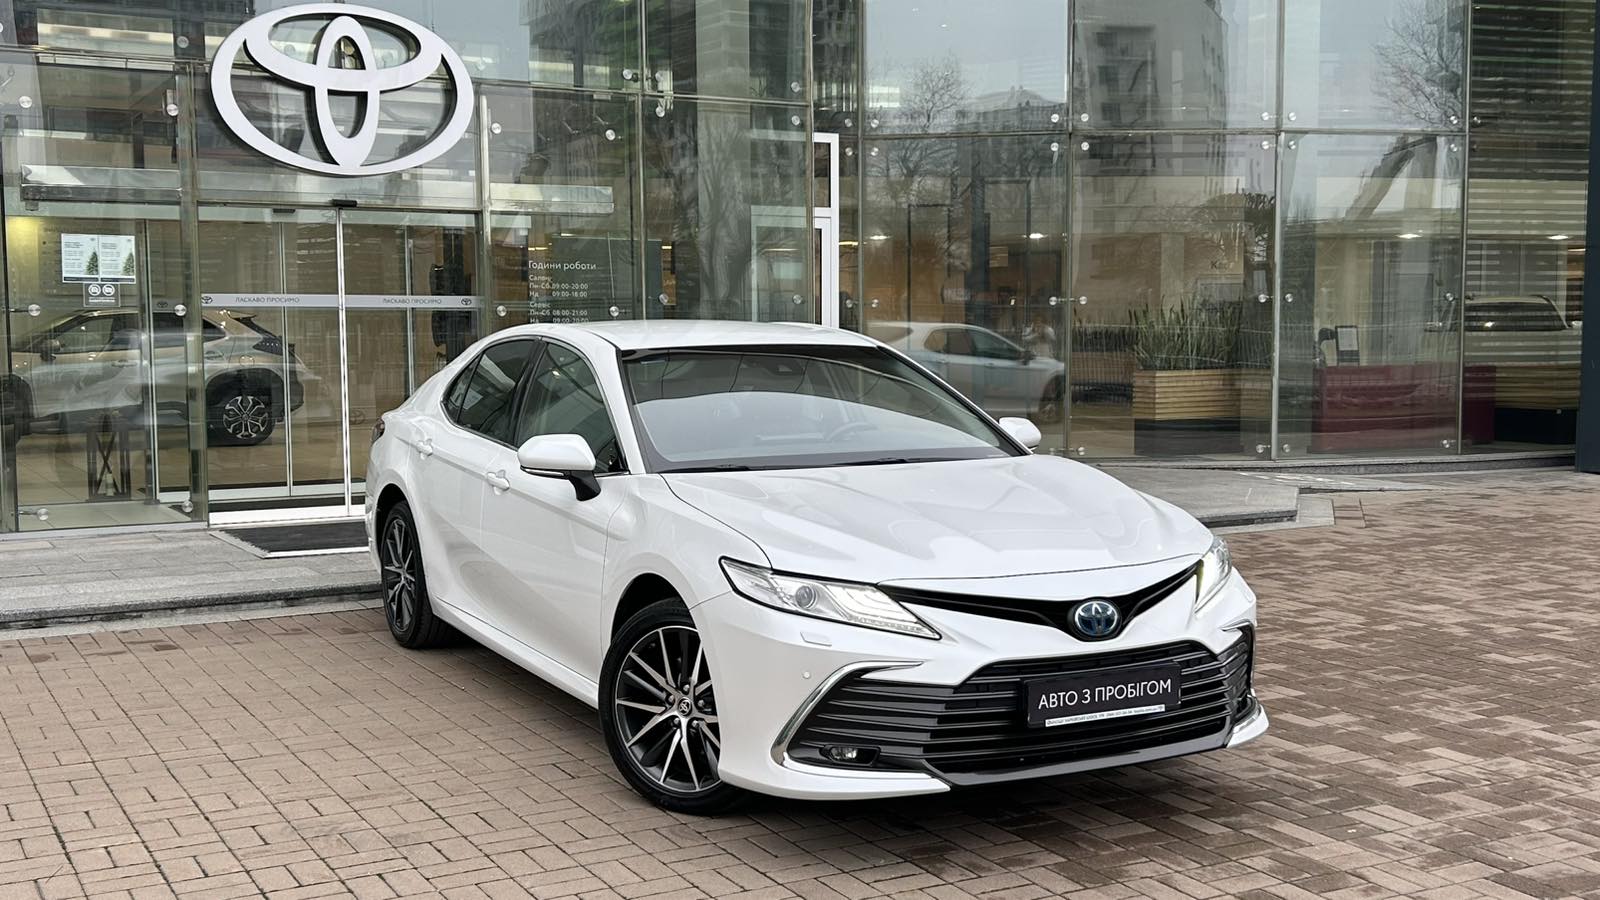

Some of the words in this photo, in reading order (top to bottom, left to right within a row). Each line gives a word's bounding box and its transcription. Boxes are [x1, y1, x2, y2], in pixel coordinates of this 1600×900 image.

[528, 260, 561, 270] Години
[563, 261, 597, 271] роботи
[1038, 690, 1078, 710] АВТО
[1081, 688, 1091, 704] З
[1095, 678, 1172, 703] ПРОБІГОМ
